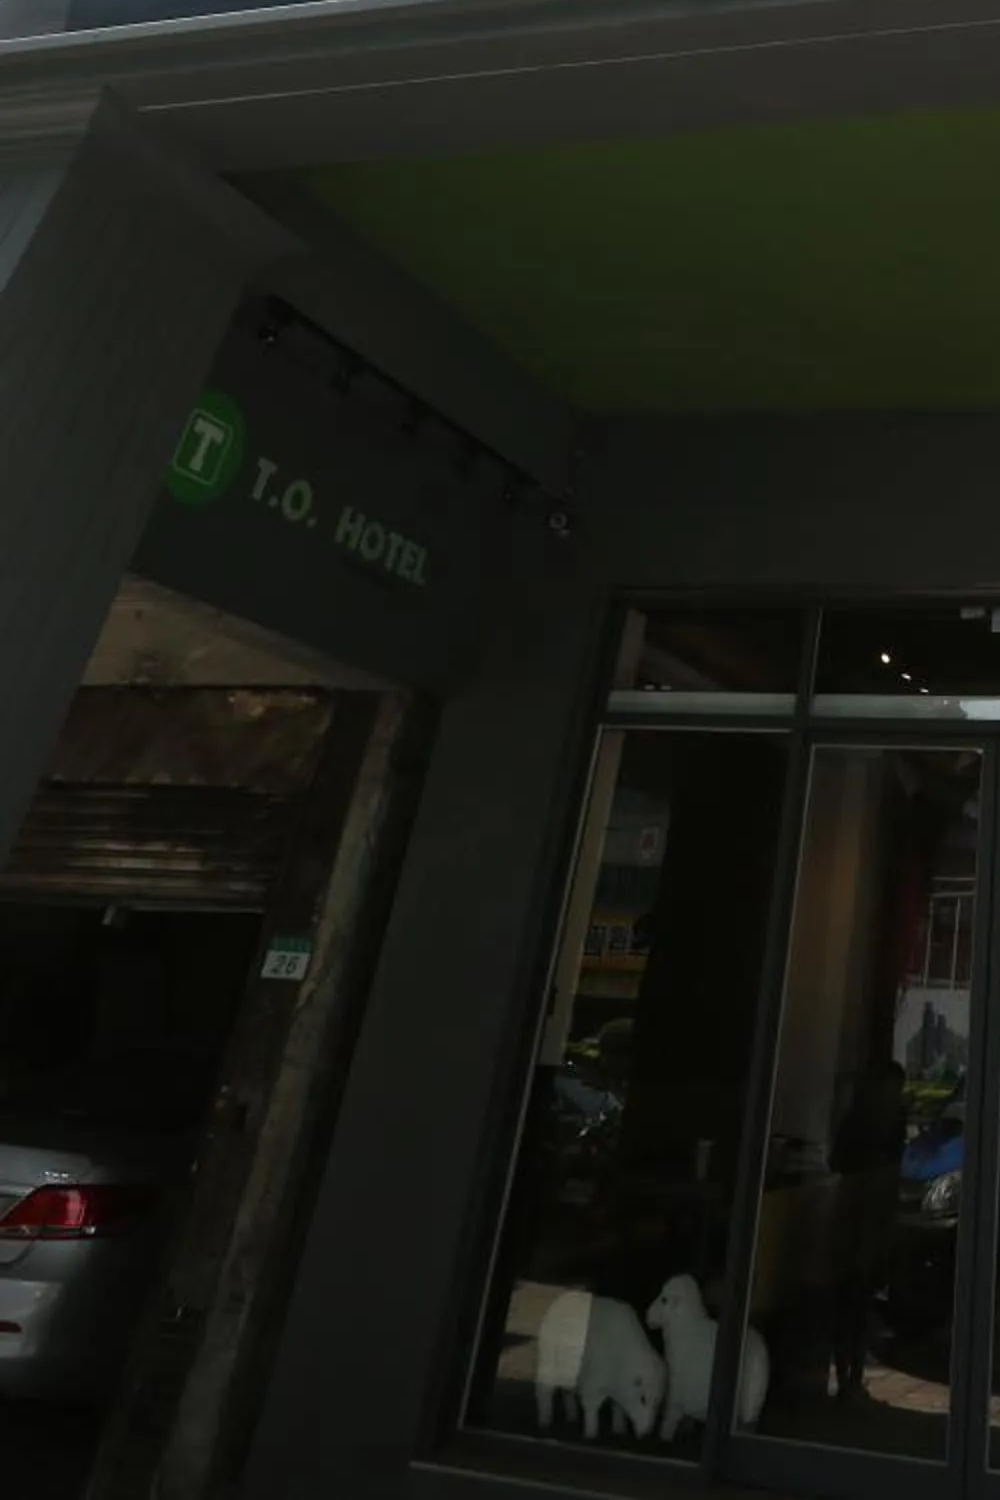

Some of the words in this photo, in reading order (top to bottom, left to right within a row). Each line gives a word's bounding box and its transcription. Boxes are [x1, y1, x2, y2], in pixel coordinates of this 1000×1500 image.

[189, 417, 225, 472] T
[253, 457, 317, 529] T.O.
[334, 505, 427, 586] HOTEL
